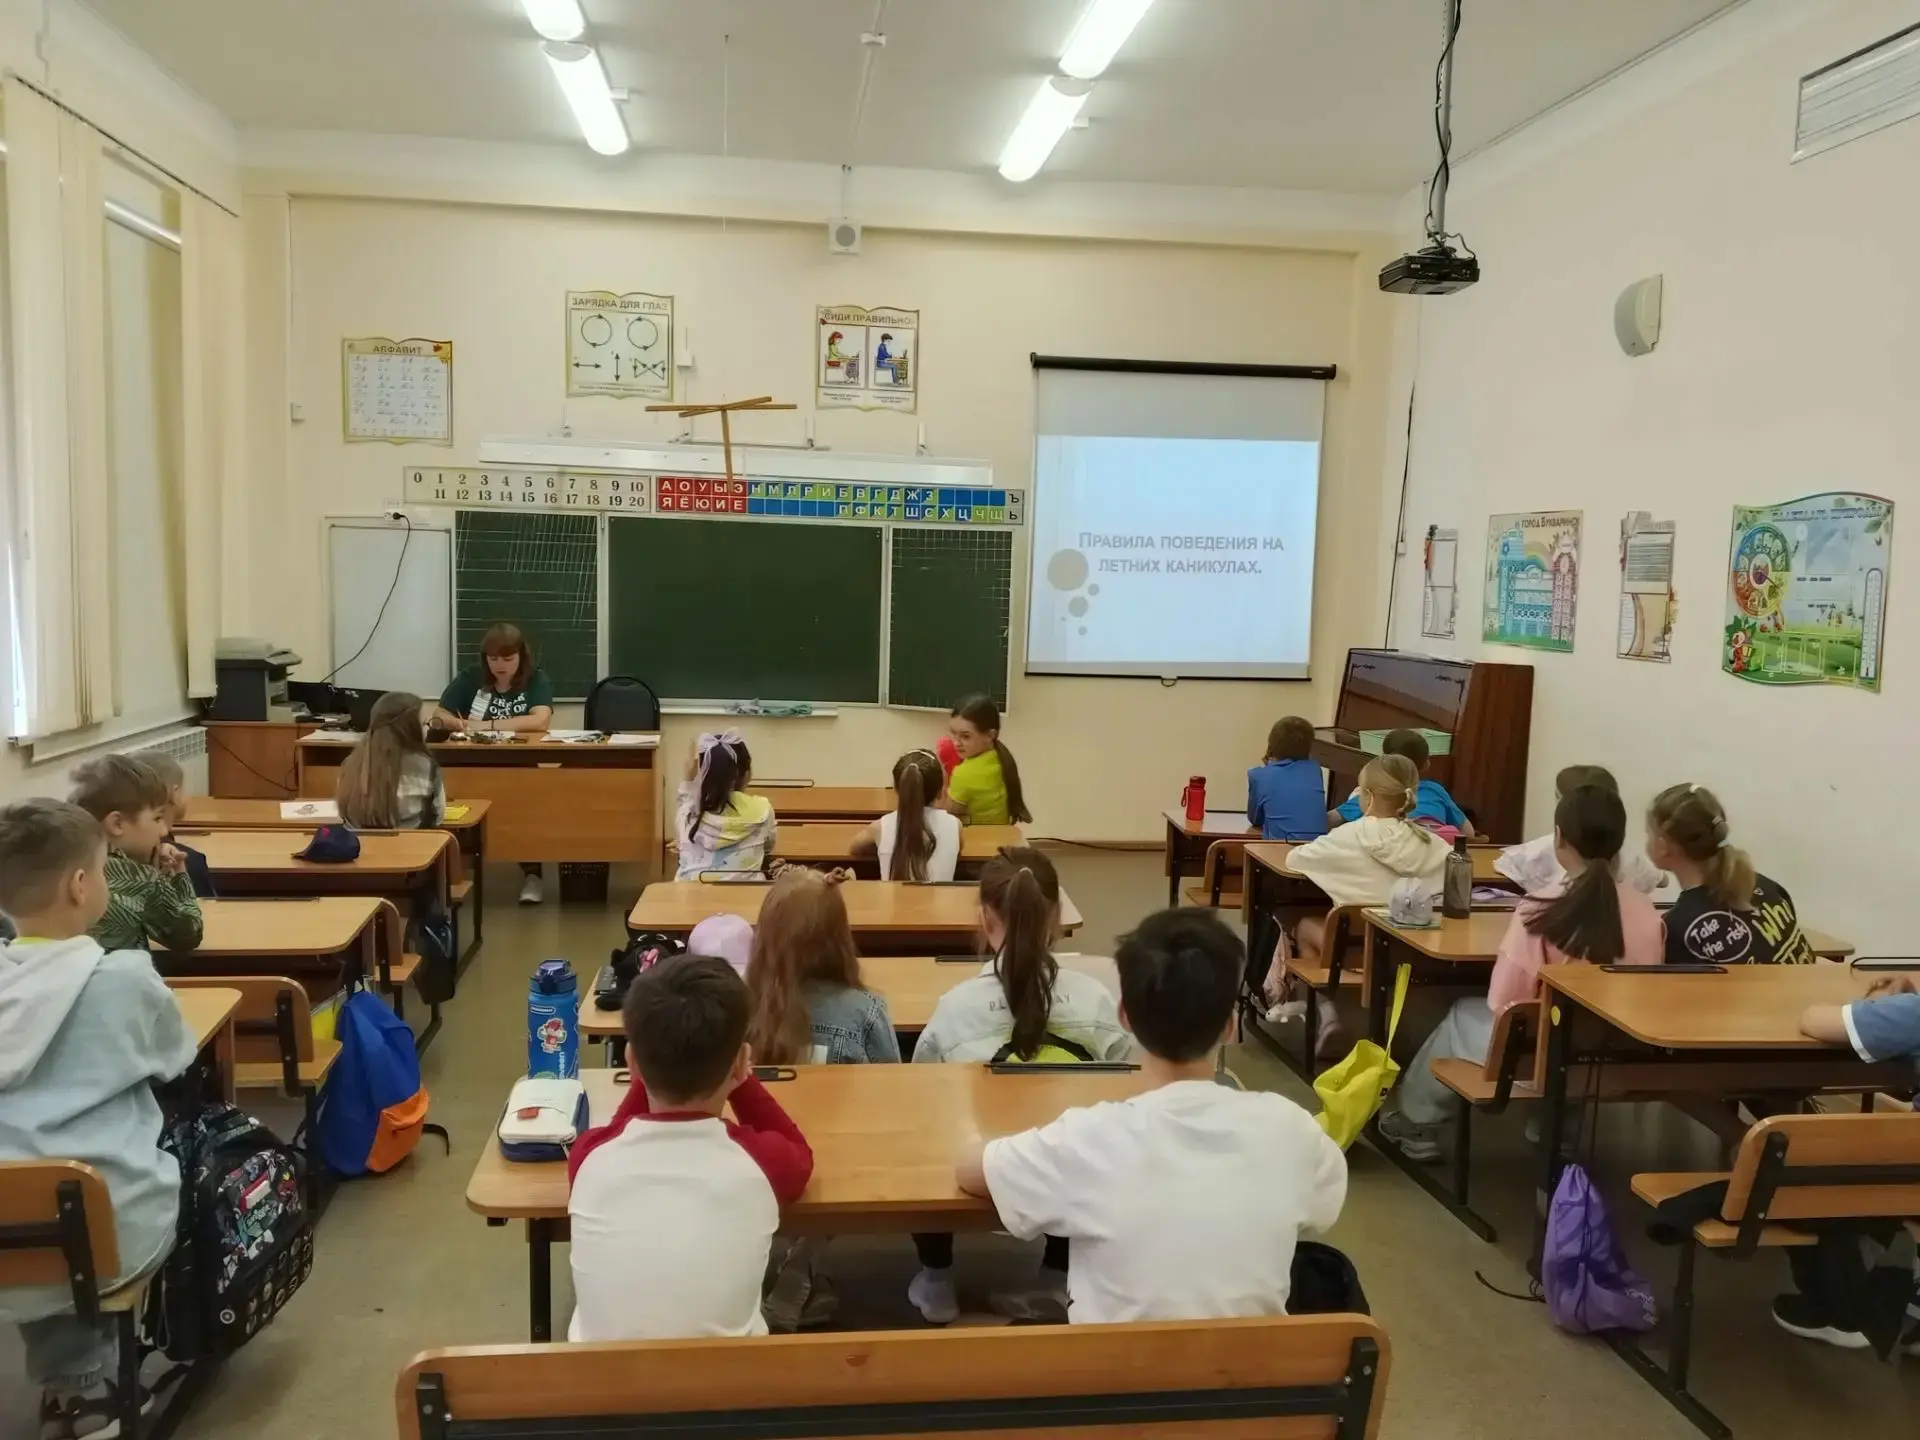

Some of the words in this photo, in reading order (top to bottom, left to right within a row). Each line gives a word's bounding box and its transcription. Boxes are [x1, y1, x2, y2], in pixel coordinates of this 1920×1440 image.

[572, 297, 617, 308] ЗАРЯДКА
[619, 300, 641, 309] ДЛЯ
[642, 302, 668, 311] ГЛАЗ
[824, 312, 851, 321] СИДИ
[373, 345, 423, 355] АЛФАВИТ
[413, 472, 422, 483] 0
[437, 473, 443, 484] 1
[458, 474, 467, 485] 2
[480, 474, 489, 486] 3
[501, 475, 510, 487] 4
[524, 476, 533, 487] 5
[546, 477, 555, 488] 6
[568, 478, 576, 489] 7
[589, 479, 598, 490] 8
[611, 480, 620, 491] 9
[629, 481, 644, 492] 10
[435, 489, 446, 499] 11
[456, 490, 469, 500] 12
[478, 490, 492, 501] 13
[499, 491, 513, 502] 14
[521, 492, 535, 503] 15
[543, 493, 557, 504] 16
[566, 493, 578, 505] 17
[587, 494, 600, 505] 18
[608, 495, 622, 506] 19
[628, 496, 645, 507] 20
[661, 481, 672, 491] А
[679, 481, 690, 492] О
[698, 482, 708, 493] У
[714, 483, 727, 493] Ы
[733, 483, 743, 493] Э
[751, 484, 761, 494] Н
[768, 485, 779, 495] М
[804, 487, 814, 496] Р
[839, 488, 848, 498] Б
[856, 488, 865, 498] В
[874, 488, 883, 499] Г
[890, 489, 901, 500] Д
[906, 489, 920, 500] Ж
[925, 490, 934, 500] З
[1008, 493, 1020, 503] Ъ
[662, 497, 672, 507] Я
[680, 496, 689, 508] Ё
[695, 498, 709, 509] Ю
[715, 499, 725, 509] И
[734, 500, 743, 510] Е
[839, 505, 848, 514] П
[855, 505, 866, 516] Ф
[873, 506, 882, 516] К
[891, 506, 900, 516] Т
[906, 506, 920, 517] Ш
[924, 507, 934, 517] С
[942, 507, 952, 517] Х
[958, 508, 970, 520] Ц
[975, 509, 985, 519] Ч
[990, 510, 1004, 521] Щ
[1009, 510, 1018, 520] Ь
[1521, 518, 1540, 528] ГОРОД
[1160, 535, 1257, 552] ПОВЕДЕНИЯ
[1262, 537, 1284, 551] НА
[1098, 558, 1160, 573] ЛЕТНИХ
[1166, 559, 1262, 574] КАНИКУЛАХ.
[513, 703, 528, 713] OF
[1690, 918, 1720, 944] Take
[1702, 940, 1725, 957] the
[1726, 923, 1749, 946] risk
